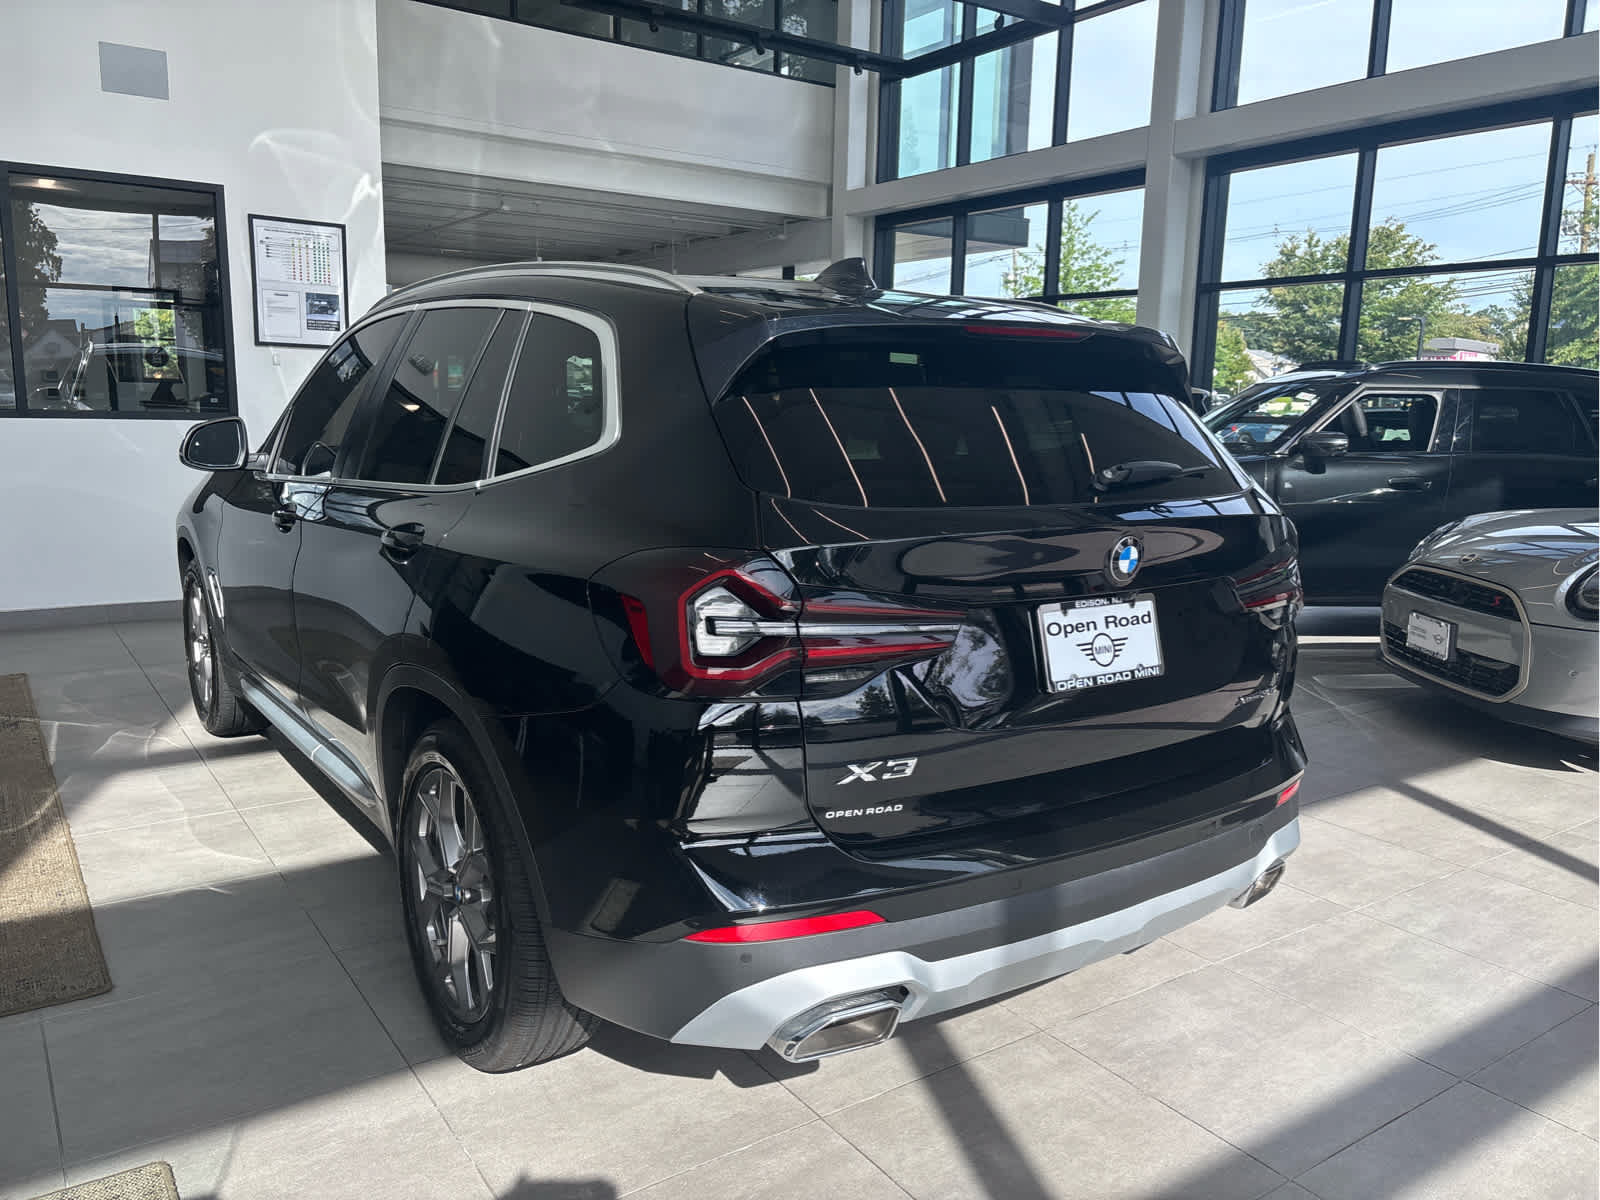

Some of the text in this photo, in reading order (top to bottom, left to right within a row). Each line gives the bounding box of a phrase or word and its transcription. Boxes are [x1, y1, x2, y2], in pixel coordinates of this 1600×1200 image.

[1047, 611, 1152, 638] Open Road
[1095, 645, 1112, 655] MINI
[1057, 666, 1160, 691] OPEN ROAD MINI
[835, 757, 918, 785] X3
[825, 804, 904, 819] OPEN ROAD
